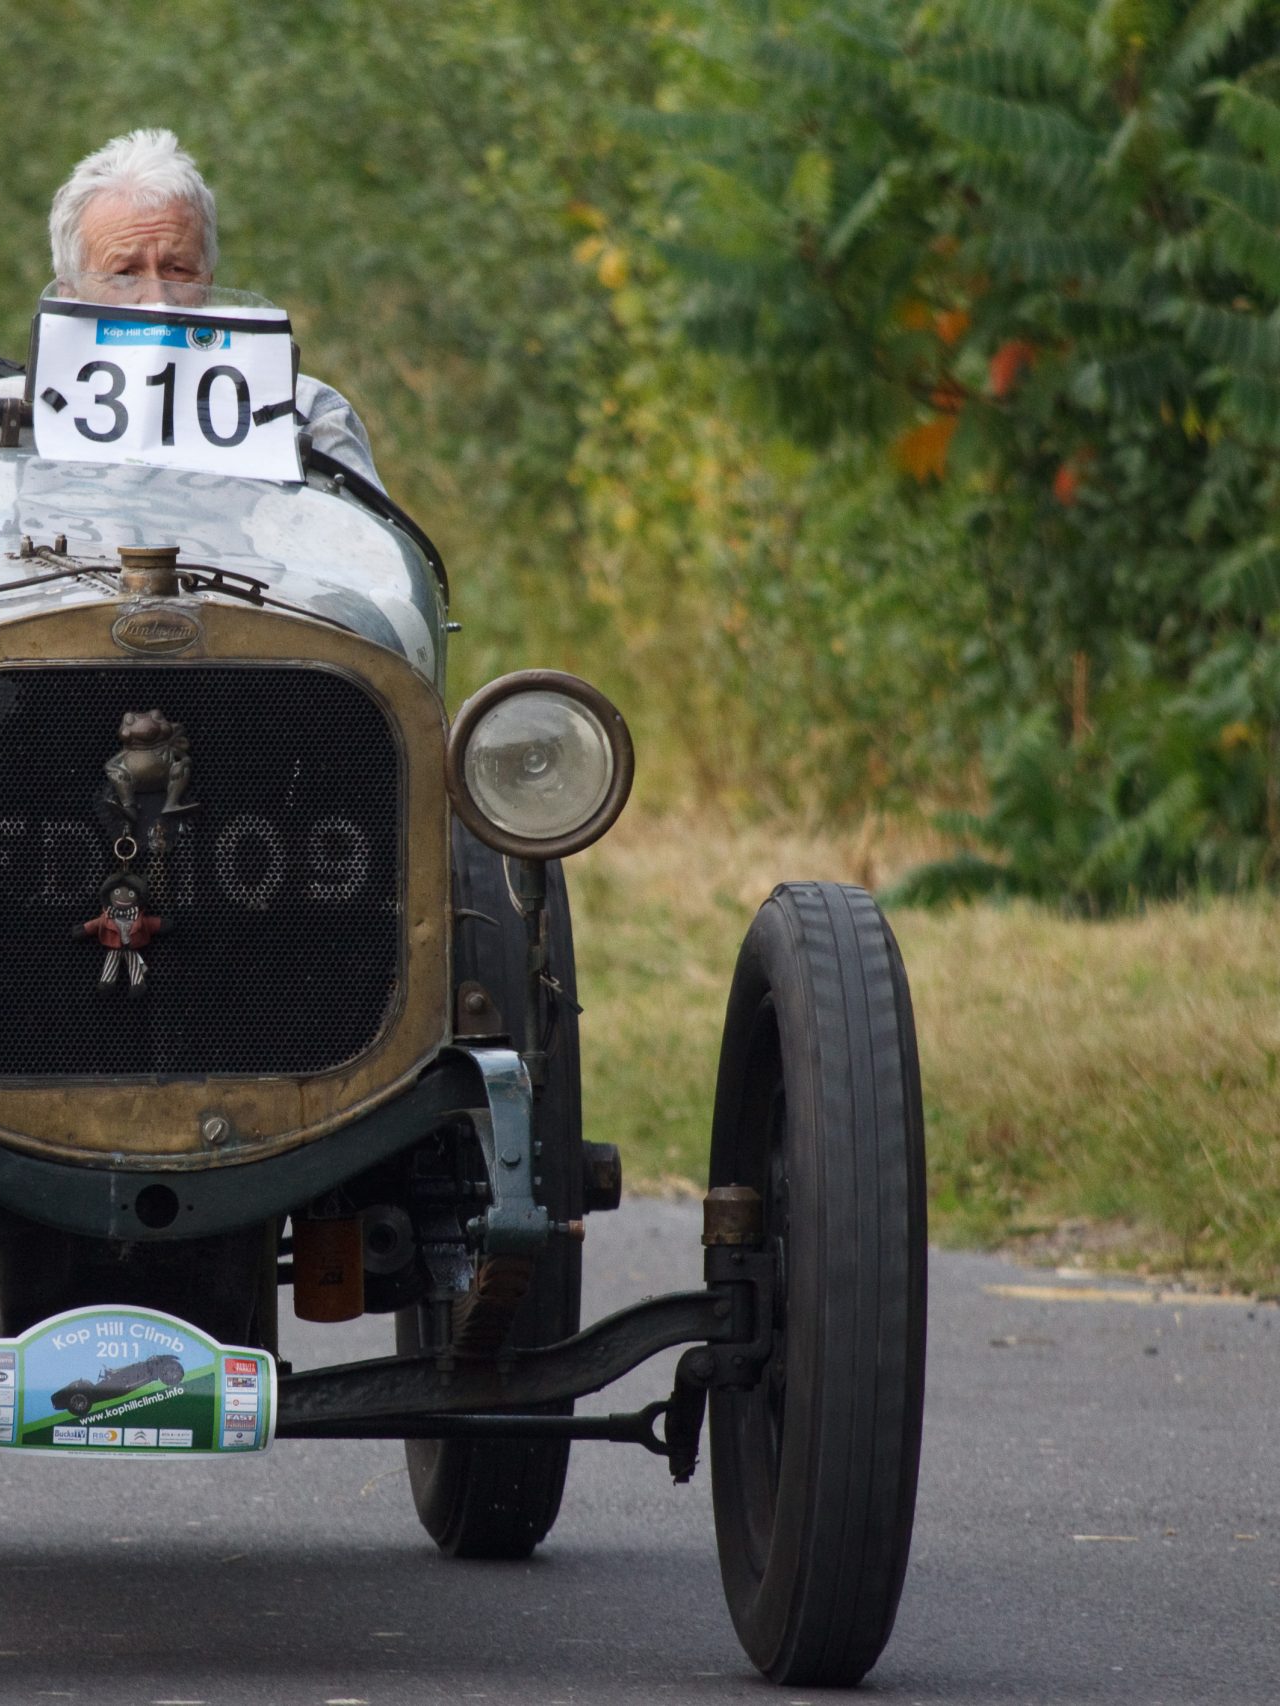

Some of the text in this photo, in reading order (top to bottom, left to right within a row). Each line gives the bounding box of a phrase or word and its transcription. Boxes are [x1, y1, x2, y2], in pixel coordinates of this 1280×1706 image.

[103, 327, 171, 337] Kop Hill Climb
[73, 360, 251, 448] 310
[52, 1321, 185, 1353] Kop Hill Climb
[96, 1342, 140, 1358] 2011
[80, 1386, 185, 1426] www.kophillclimb.info
